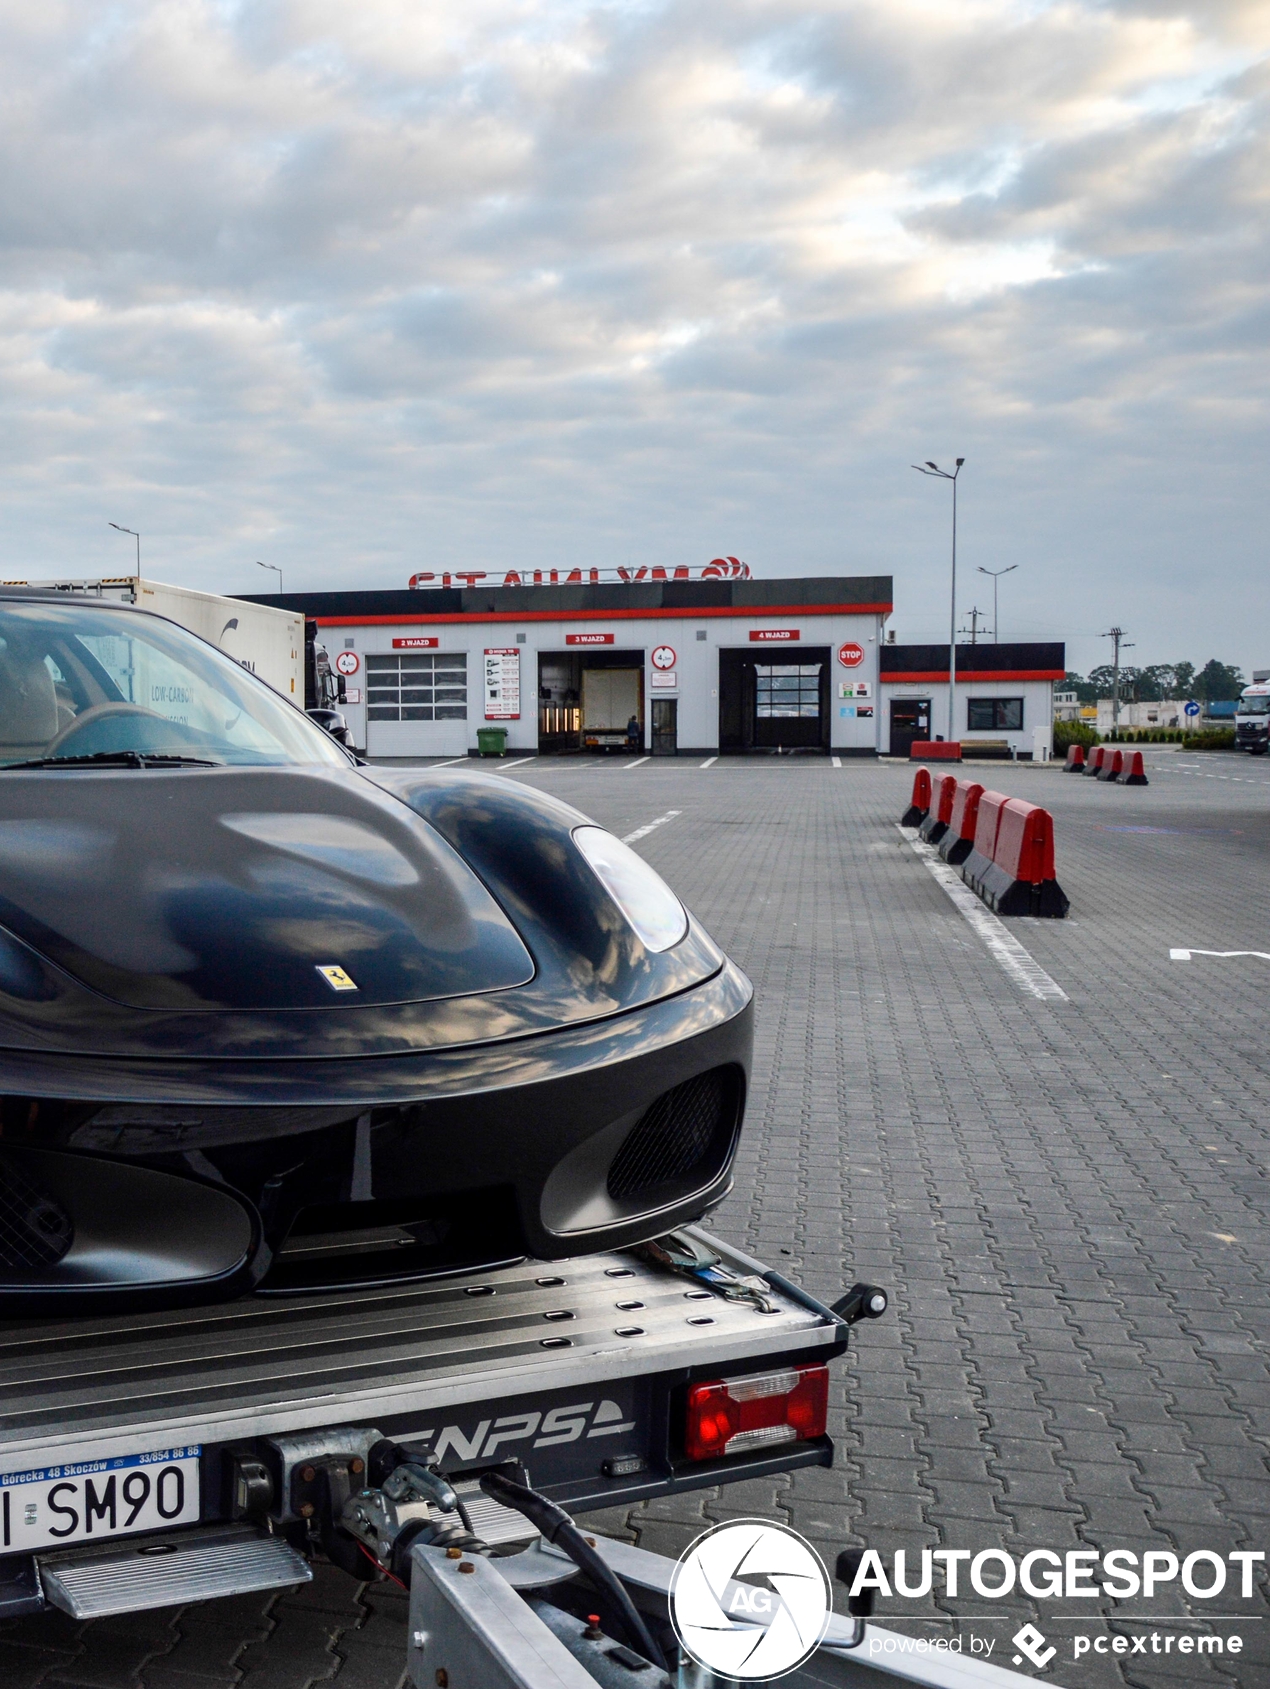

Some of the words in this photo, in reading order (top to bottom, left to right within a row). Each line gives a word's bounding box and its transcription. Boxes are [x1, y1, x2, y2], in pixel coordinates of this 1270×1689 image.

[841, 650, 861, 659] STOP
[2, 1470, 44, 1486] Górecka
[48, 1468, 61, 1479] 48
[64, 1460, 108, 1476] Skoczów
[139, 1451, 170, 1464] 33/854
[172, 1448, 184, 1458] 86
[187, 1445, 199, 1456] 86
[48, 1466, 184, 1538] SM90
